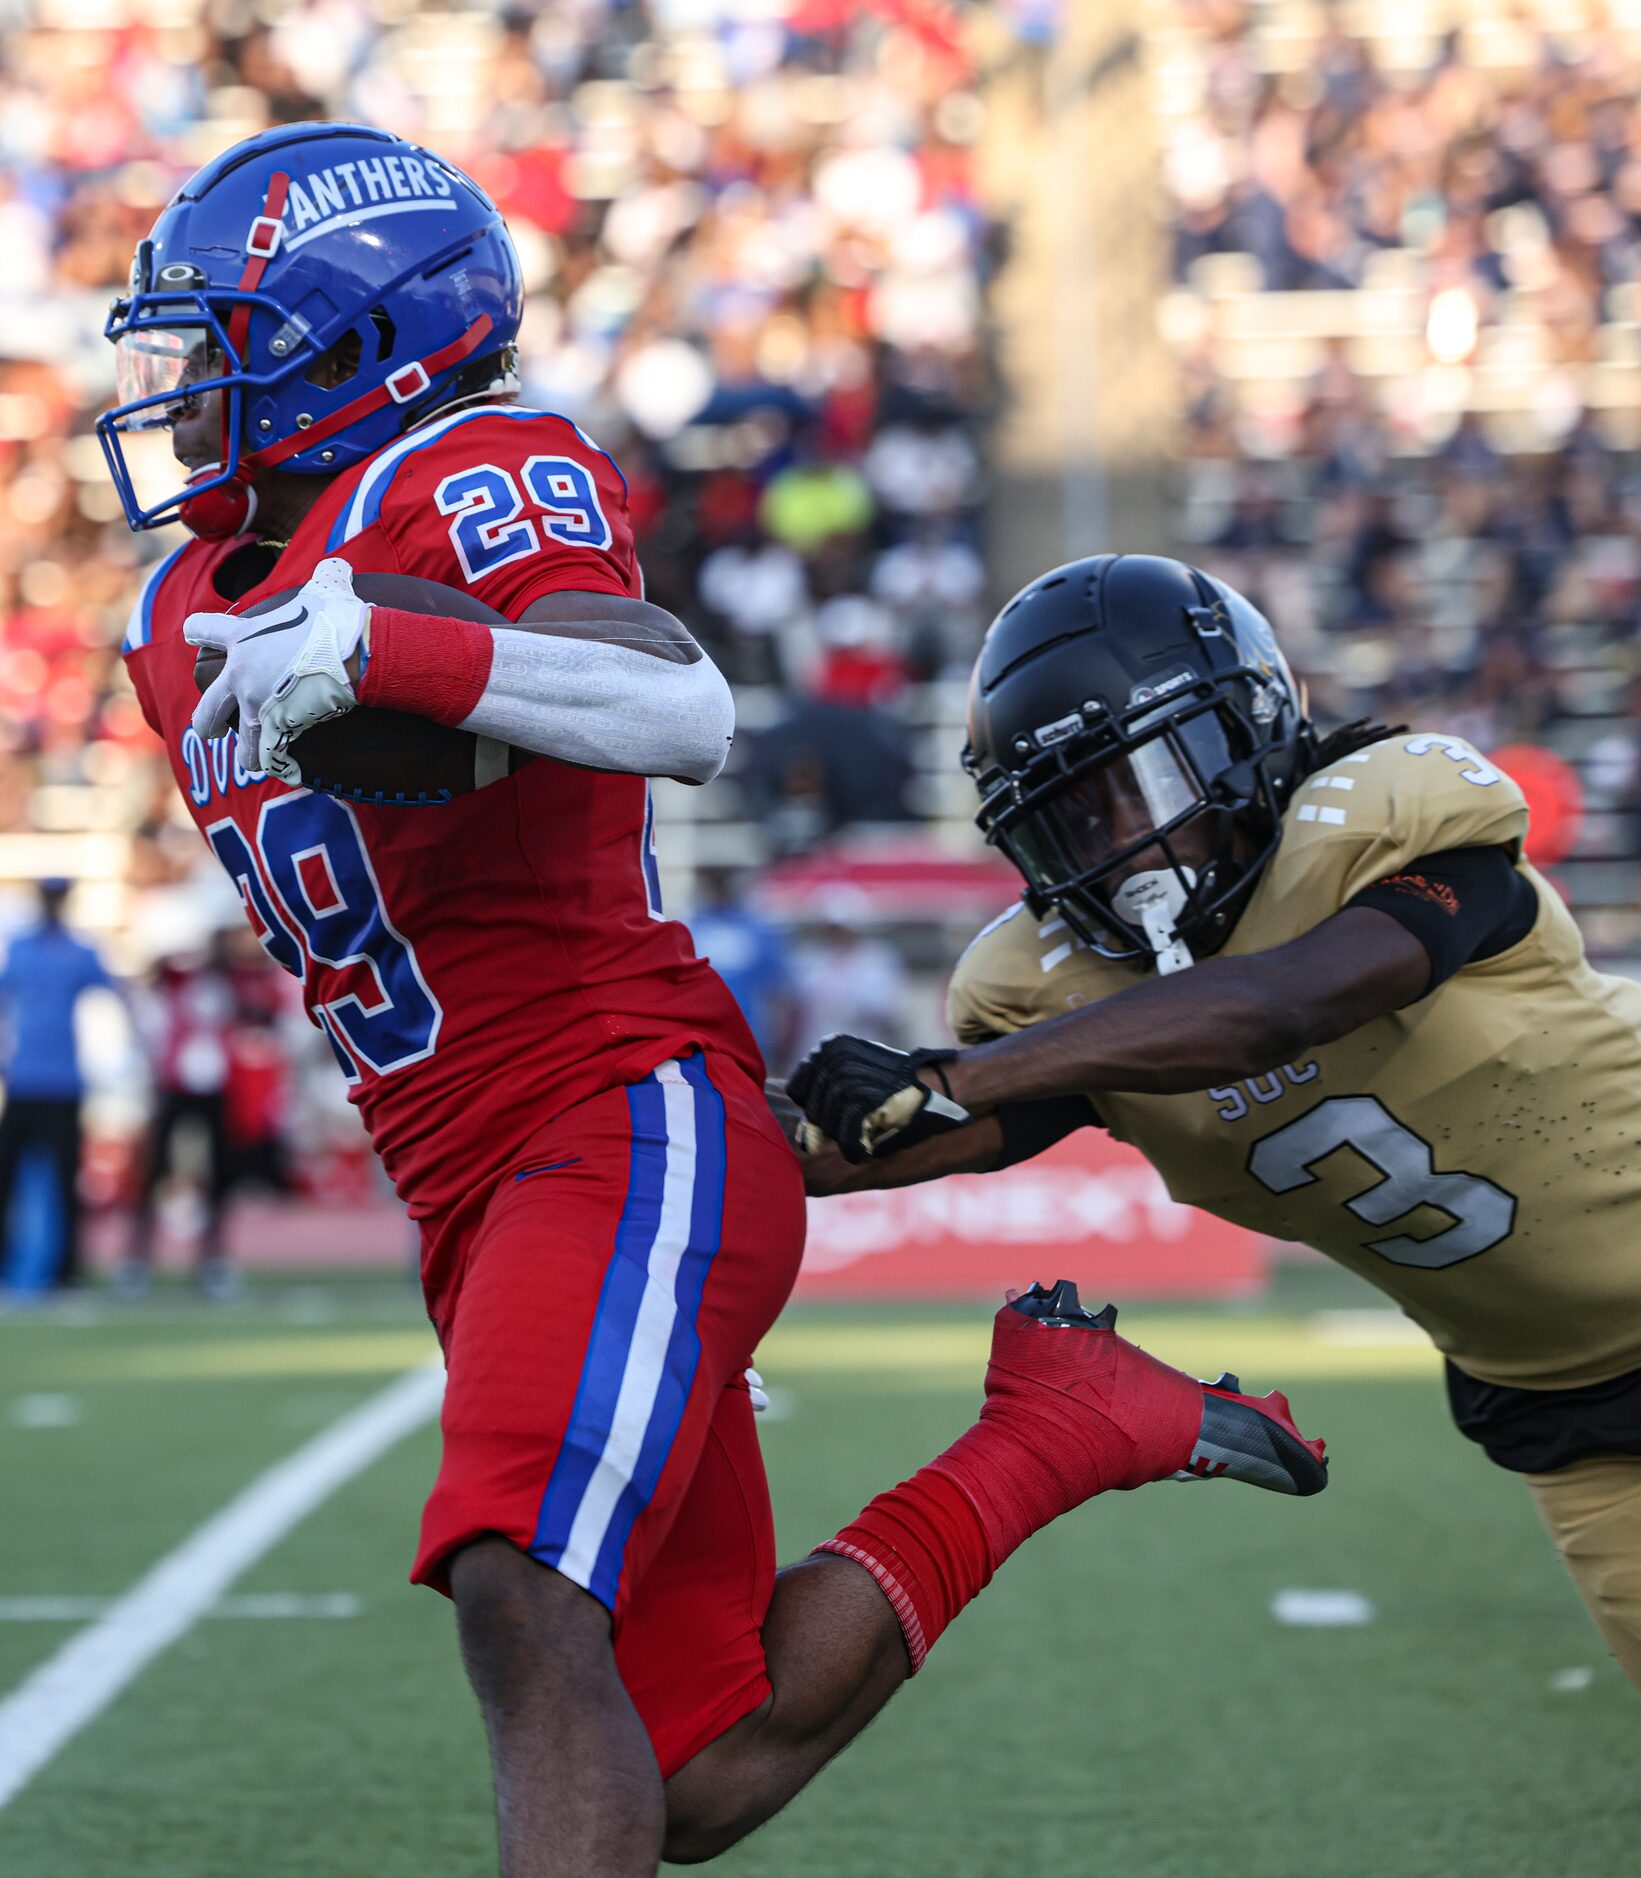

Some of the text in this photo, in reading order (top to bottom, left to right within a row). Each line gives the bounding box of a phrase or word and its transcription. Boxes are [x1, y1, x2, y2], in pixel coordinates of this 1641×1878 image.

[433, 455, 613, 584] 29
[1404, 736, 1501, 786] 3
[1246, 1093, 1518, 1270] 3
